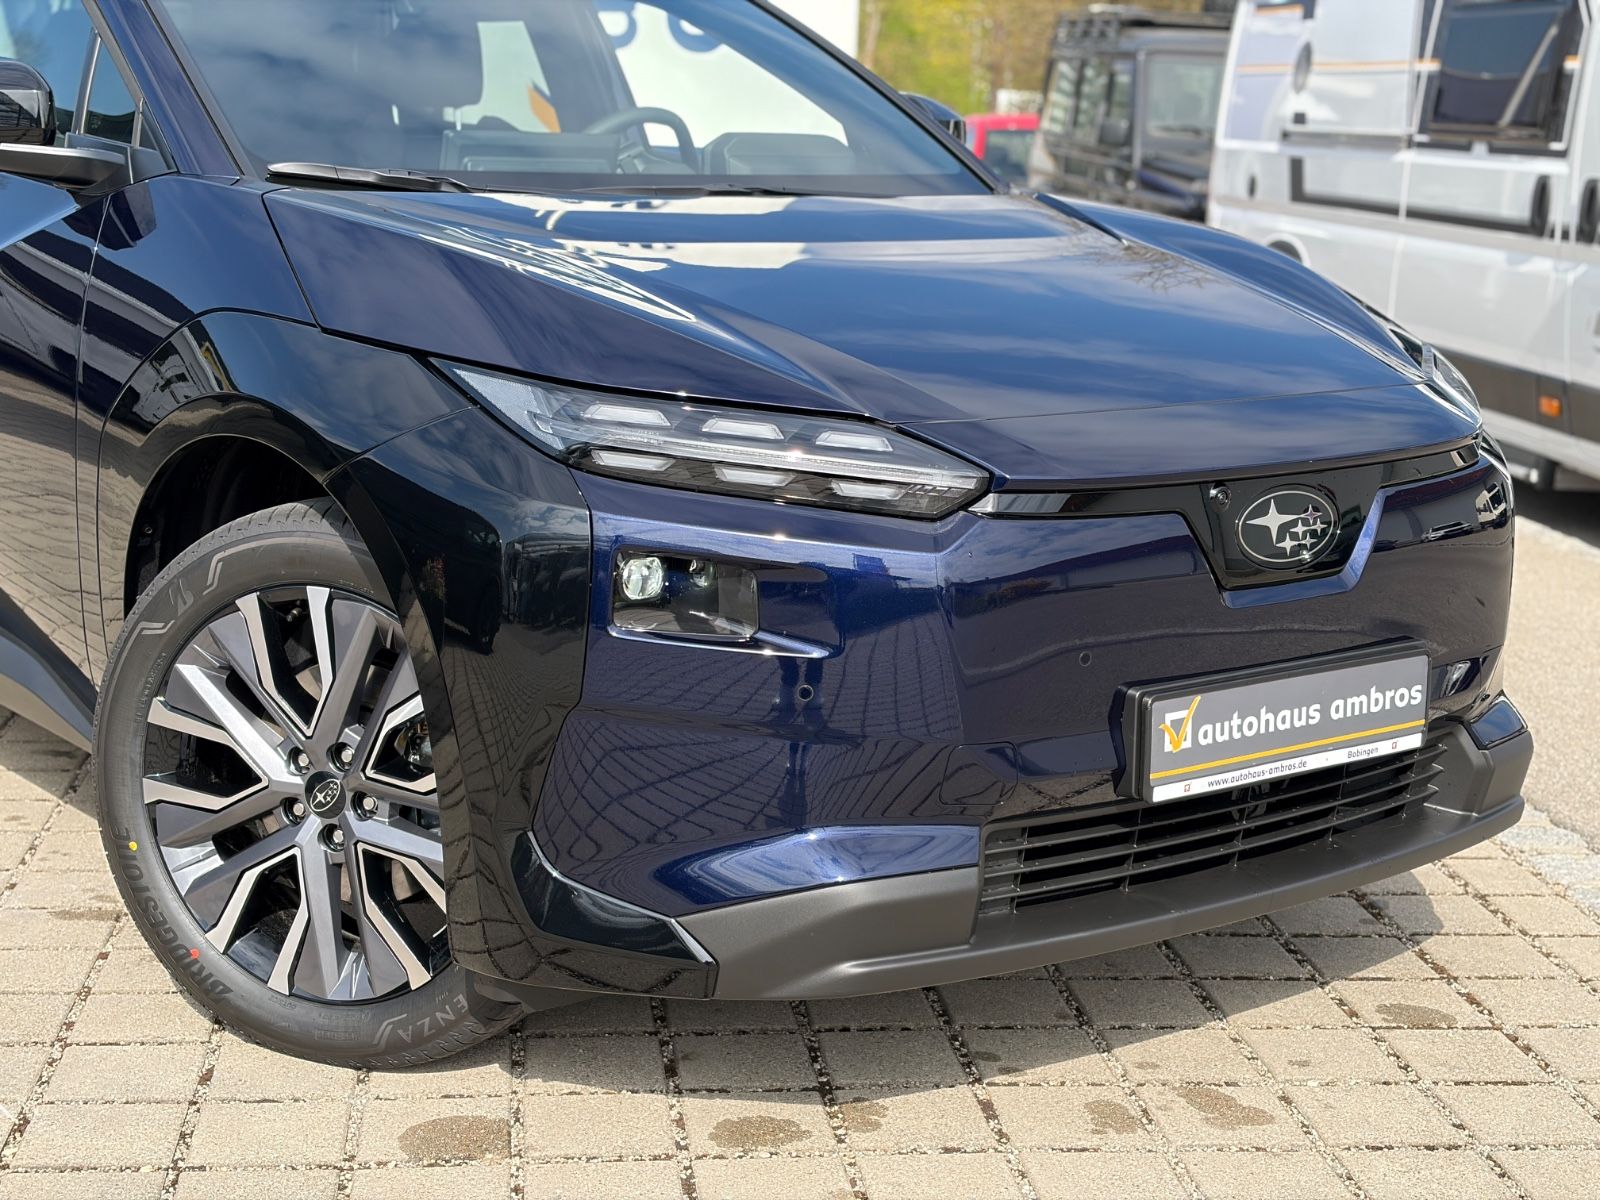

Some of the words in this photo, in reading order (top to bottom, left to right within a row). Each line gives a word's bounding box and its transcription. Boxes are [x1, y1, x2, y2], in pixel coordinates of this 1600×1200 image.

[1197, 705, 1320, 746] autohaus
[1329, 684, 1423, 720] ambros
[1347, 746, 1379, 759] Bobingen
[1207, 760, 1308, 788] www.autohaus-ambros.de
[397, 993, 469, 1044] ENZA
